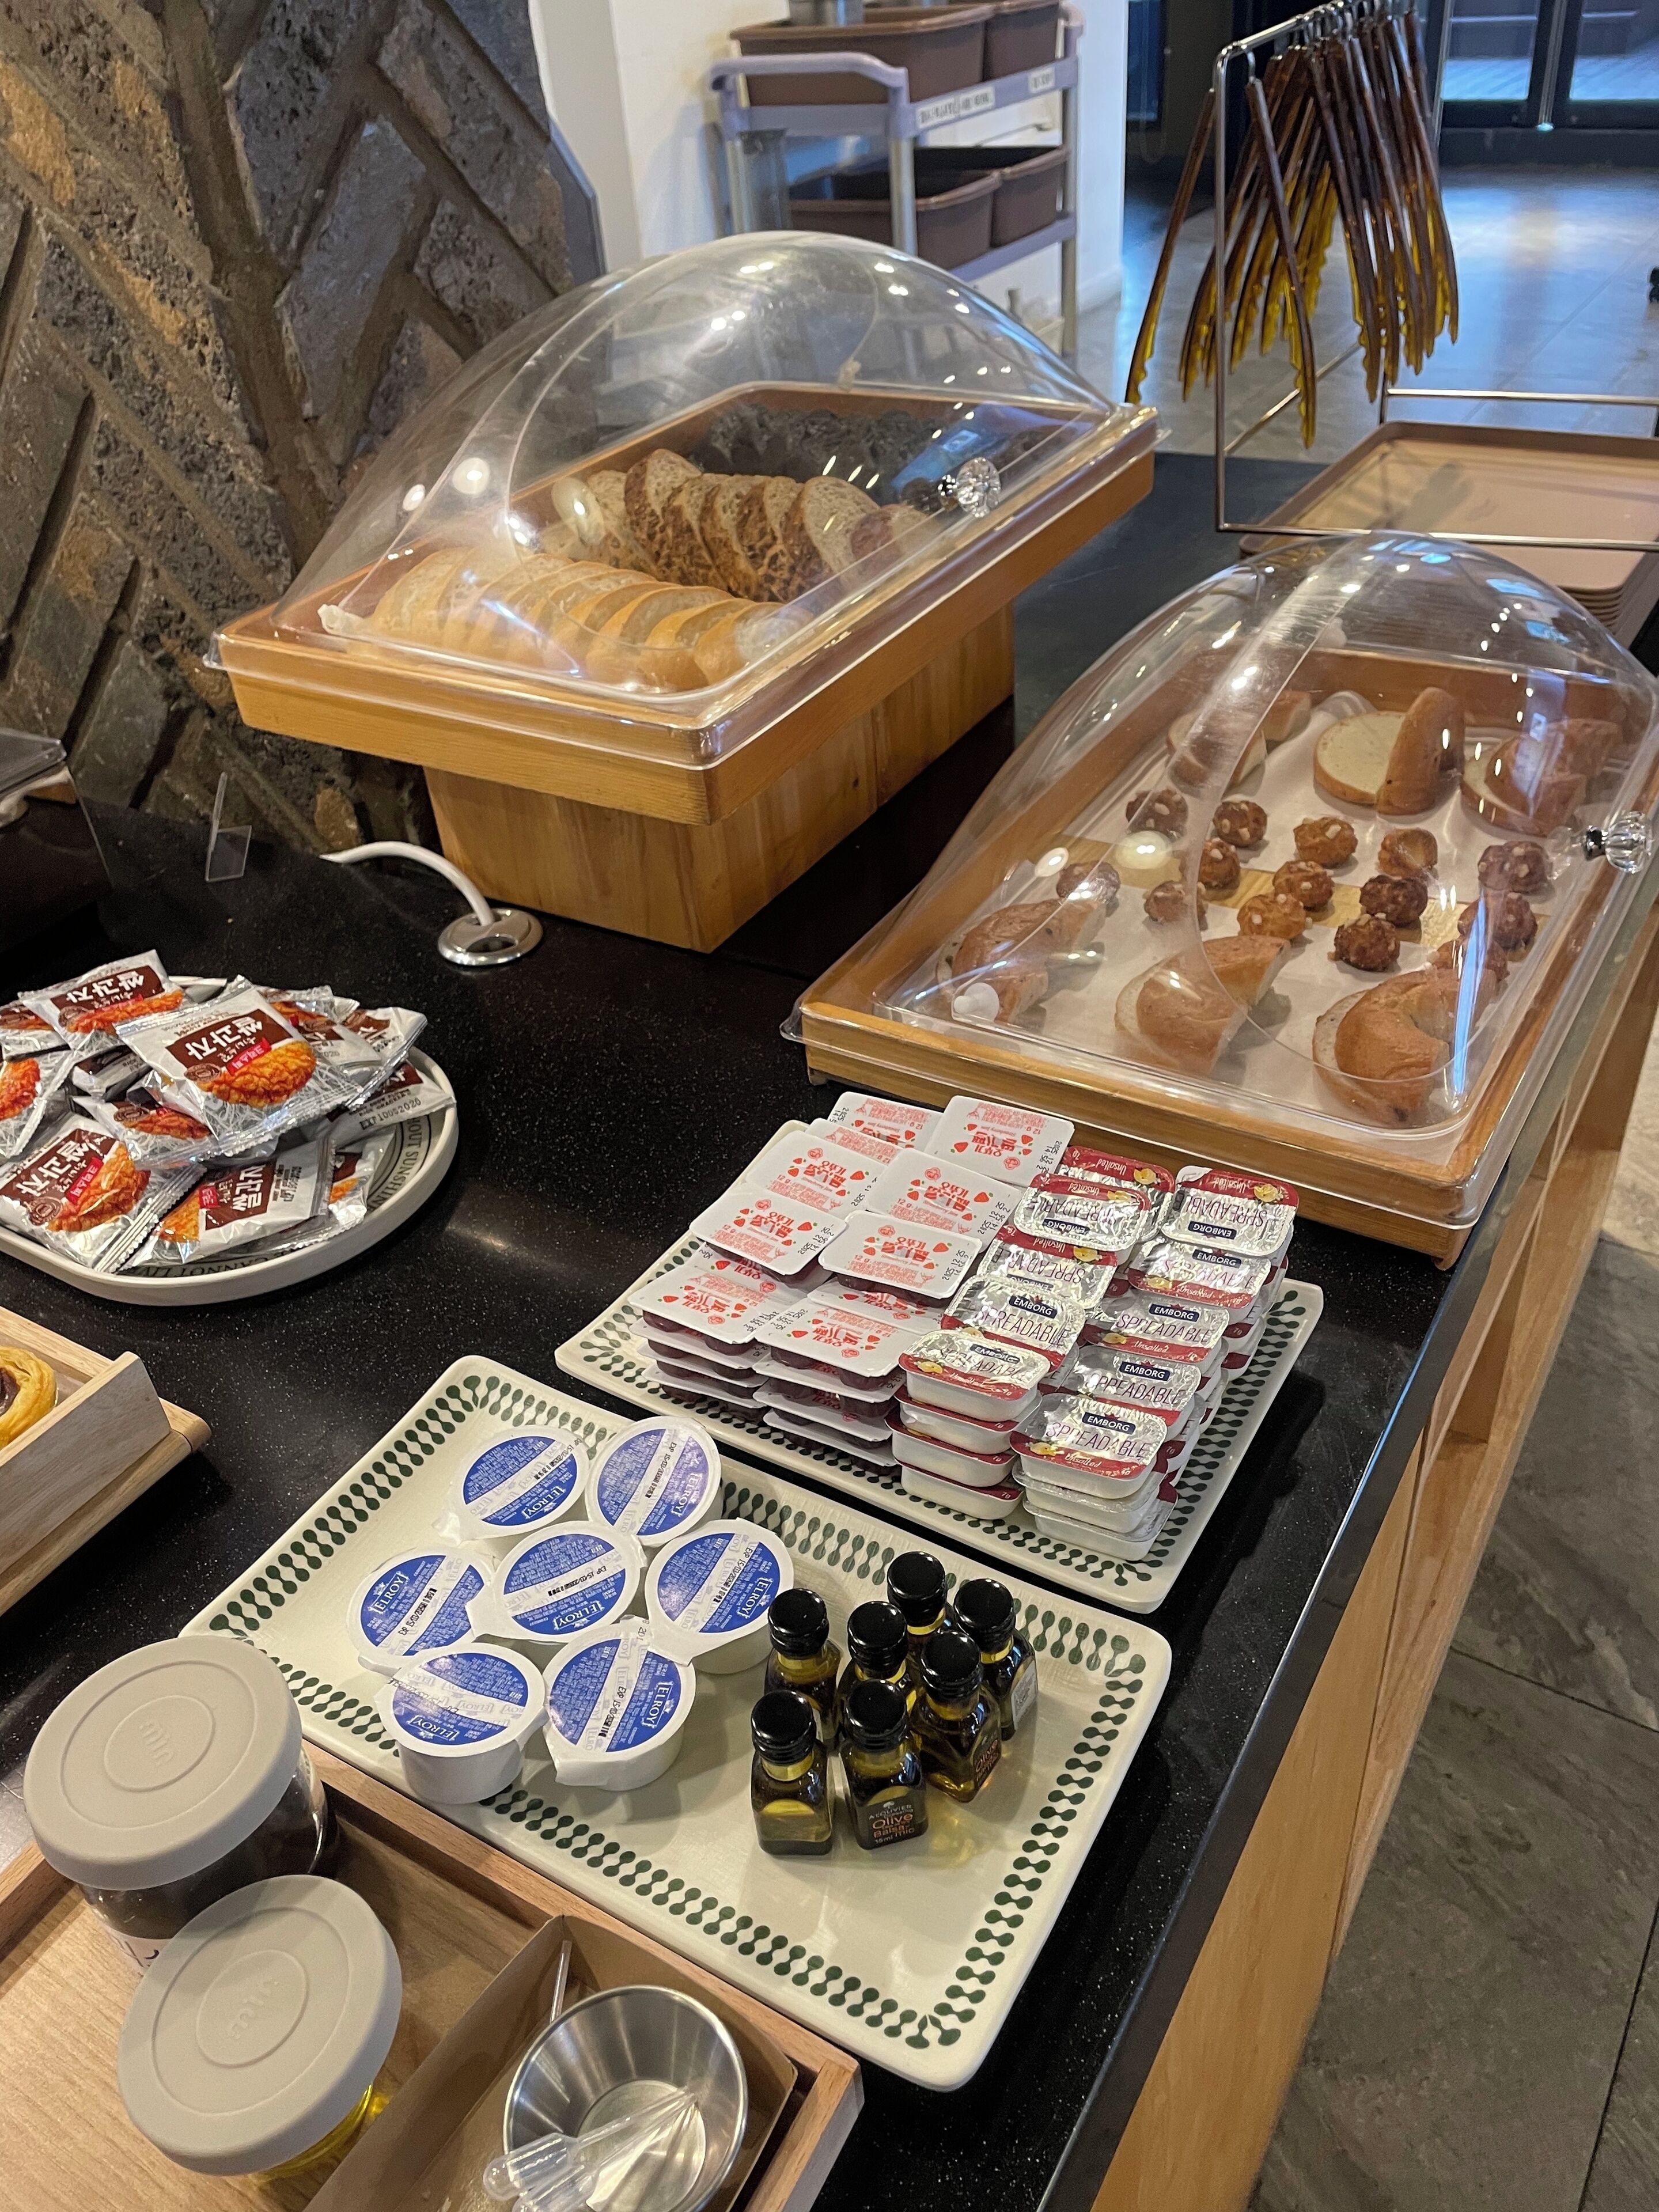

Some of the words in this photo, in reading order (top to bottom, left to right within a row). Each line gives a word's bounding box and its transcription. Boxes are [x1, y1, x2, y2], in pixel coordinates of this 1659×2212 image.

[66, 971, 144, 1003] 쌀과자
[185, 1017, 263, 1060] 쌀과자
[16, 1141, 89, 1196] 쌀과자
[1097, 1159, 1127, 1175] Unsalted
[232, 1165, 266, 1211] 쌀과자
[1067, 1183, 1100, 1196] Unsalted
[1186, 1196, 1267, 1227] SPREADABL
[1047, 1221, 1086, 1234] EMBORG
[1193, 1224, 1232, 1237] EMBORG
[1033, 1237, 1066, 1253] Unsalted
[1196, 1252, 1237, 1266] EMBORG
[1014, 1298, 1053, 1315] EMBORG
[1154, 1306, 1194, 1320] EMBORG
[1117, 1314, 1214, 1343] SPREADABLE
[1134, 1340, 1169, 1353] Unsalted
[1124, 1365, 1165, 1378] EMBORG
[1088, 1373, 1185, 1404] PREADABLE
[1088, 1415, 1130, 1431] EMBORG
[1047, 1422, 1152, 1457] SPREADABLE
[1065, 1453, 1102, 1468] Unsalted
[529, 1486, 561, 1515] ELROY
[678, 1475, 699, 1512] ELROY
[743, 1547, 753, 1558] EXP
[376, 1577, 403, 1612] ELROY
[744, 1581, 769, 1614] ELROY
[559, 1604, 599, 1626] ELROY
[616, 1687, 626, 1698] EXP
[650, 1687, 669, 1723] ELROY
[414, 1717, 454, 1738] ELROY
[872, 1813, 913, 1830] Olive
